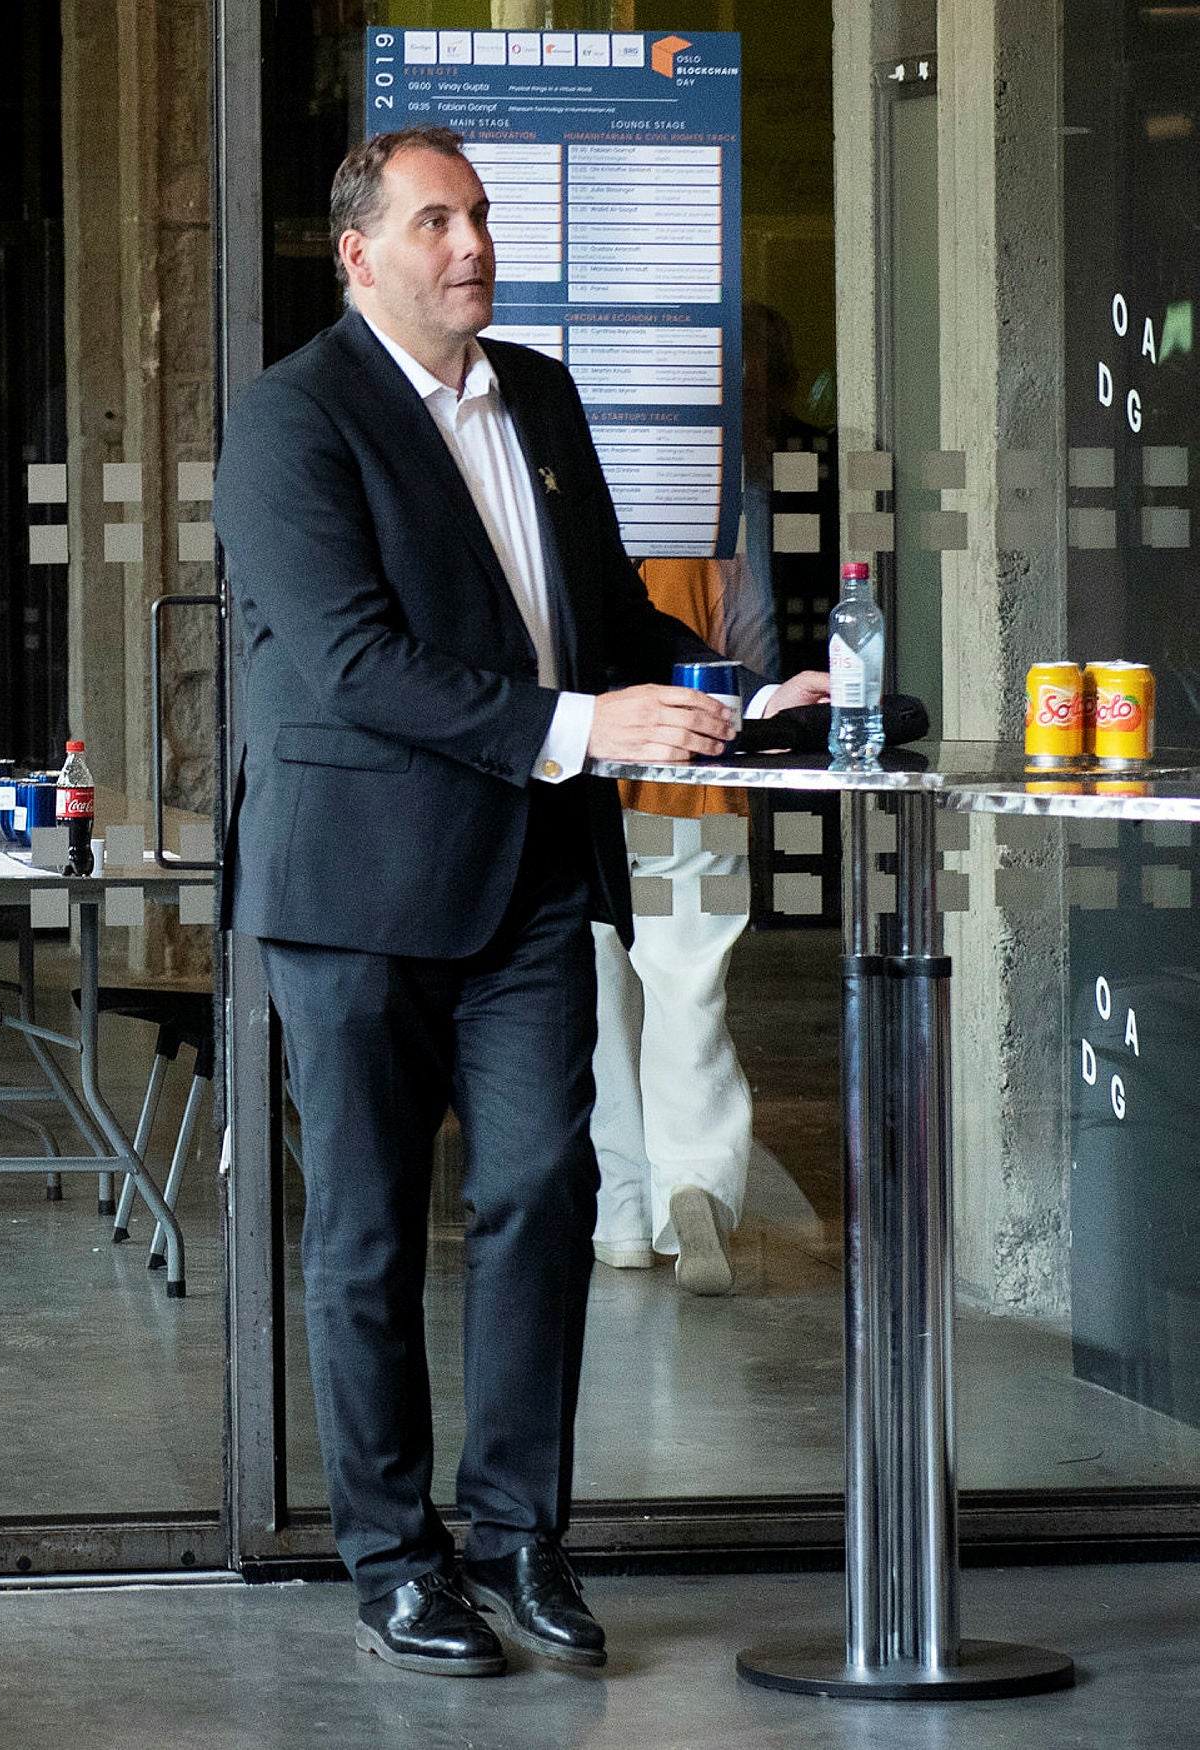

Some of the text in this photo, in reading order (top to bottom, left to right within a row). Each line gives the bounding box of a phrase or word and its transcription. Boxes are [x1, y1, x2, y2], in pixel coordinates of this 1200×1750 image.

[676, 55, 701, 64] OSLO
[375, 33, 394, 109] 2019
[676, 67, 738, 76] BLOCKCHAIN
[437, 82, 462, 93] Vinay
[463, 82, 490, 93] Gupta
[676, 78, 695, 87] DAY
[437, 102, 467, 112] Fabian
[467, 102, 498, 114] Gompf
[450, 118, 509, 128] MAIN STAGE
[610, 120, 686, 130] LOUNGE STAGE
[478, 131, 537, 140] INNOVATION
[563, 132, 633, 141] HUMANITARIAN
[706, 134, 737, 143] TRACK
[1142, 317, 1156, 364] A
[1099, 361, 1142, 433] D G
[829, 656, 852, 669] RIS
[1096, 694, 1132, 720] olo
[1124, 1008, 1139, 1057] A
[1082, 1038, 1126, 1120] D G
